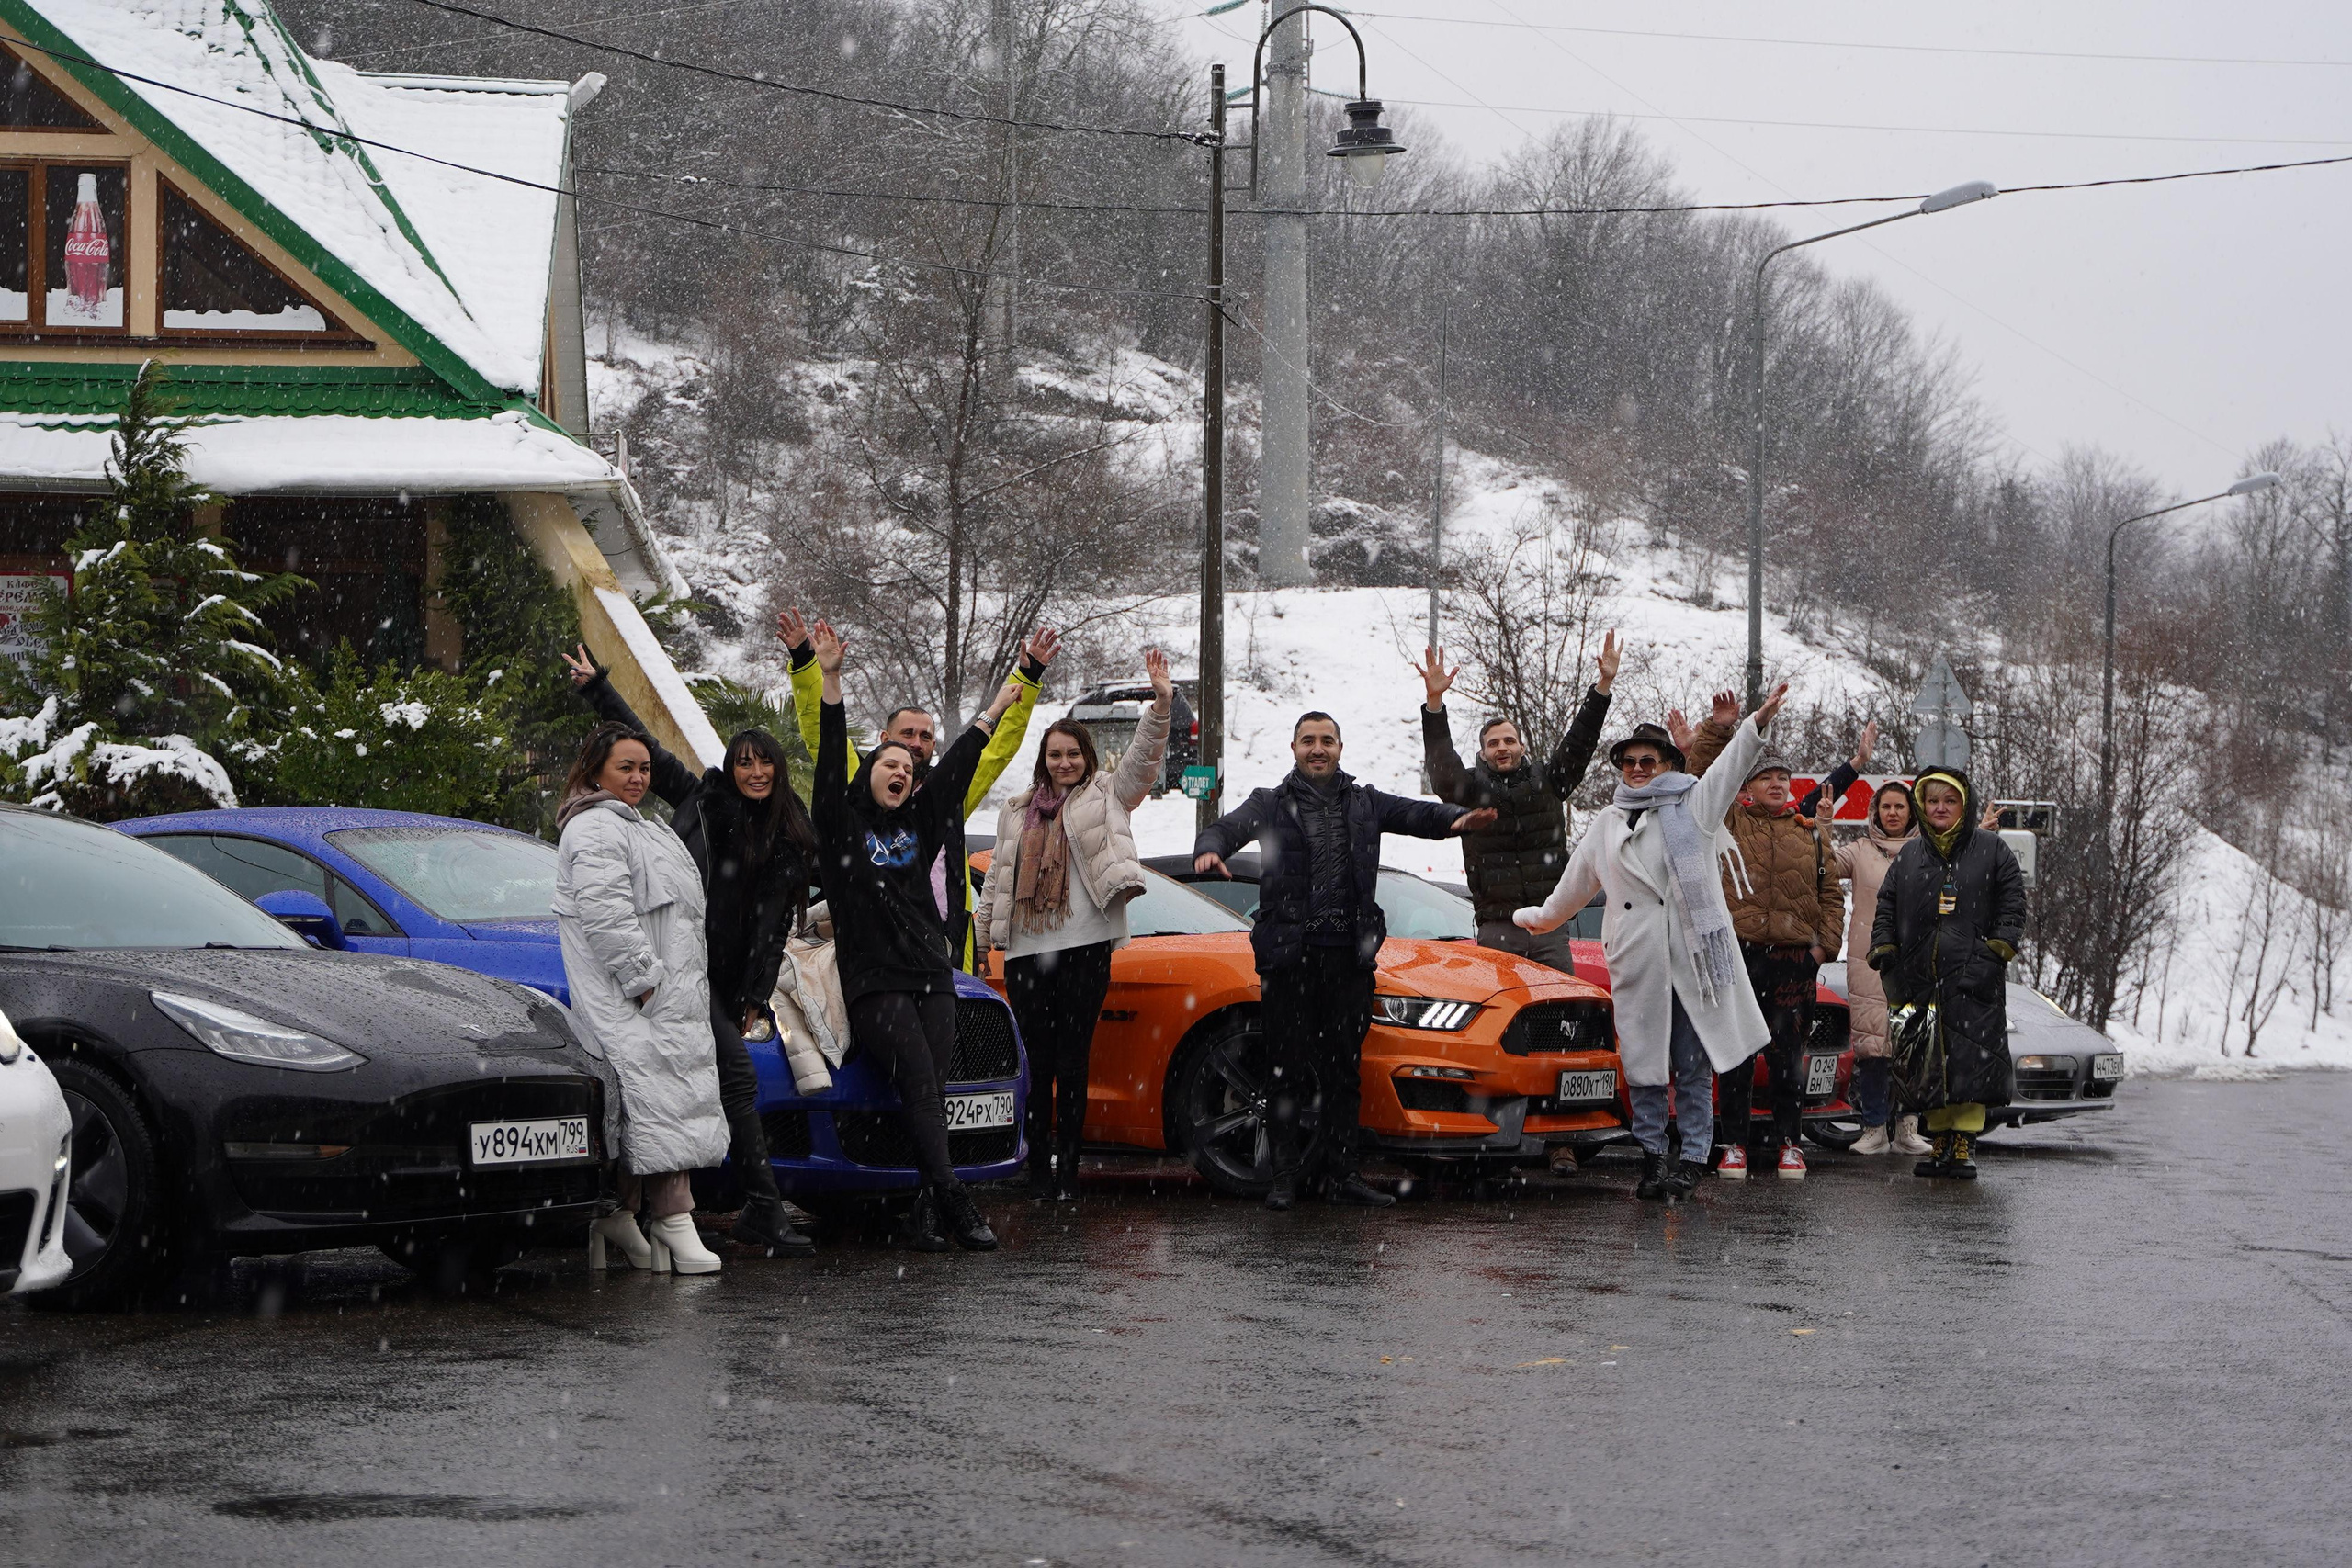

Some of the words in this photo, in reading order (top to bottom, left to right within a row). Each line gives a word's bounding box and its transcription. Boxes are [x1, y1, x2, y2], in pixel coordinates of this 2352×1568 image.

[65, 238, 109, 256] Coca-Cola
[1188, 776, 1210, 788] ТУАЛЕТ
[1600, 1073, 1613, 1089] 198
[994, 1095, 1012, 1115] 790
[479, 1125, 559, 1159] У894ХМ
[560, 1121, 584, 1145] 799
[566, 1145, 579, 1154] RUS
